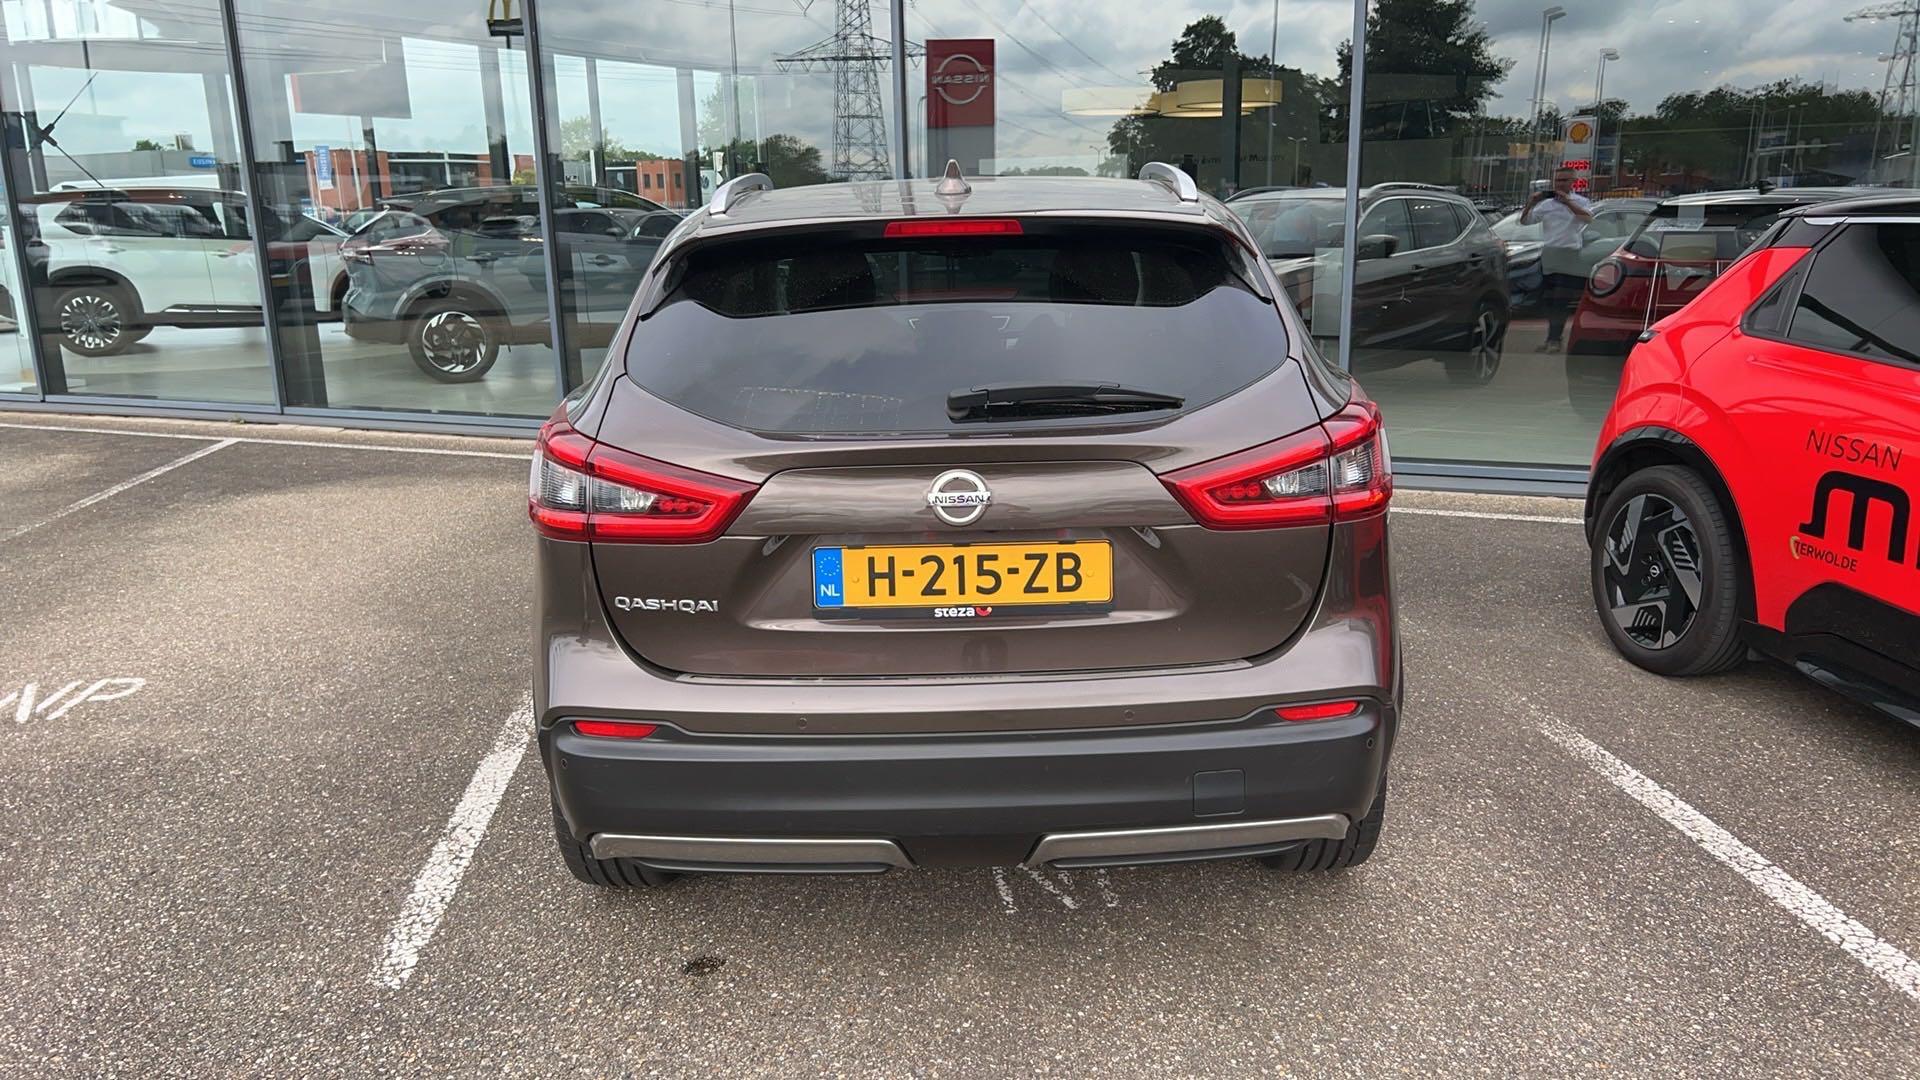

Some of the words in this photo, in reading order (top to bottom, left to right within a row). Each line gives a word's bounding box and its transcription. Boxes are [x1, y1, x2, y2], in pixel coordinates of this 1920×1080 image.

[1806, 429, 1902, 472] NISSAN
[934, 494, 985, 504] NISSAN
[1793, 540, 1858, 573] TERWOLDE
[867, 551, 1083, 597] H-215-ZB
[819, 583, 840, 597] NL
[614, 596, 719, 614] QASHQAI
[934, 606, 975, 618] steza
